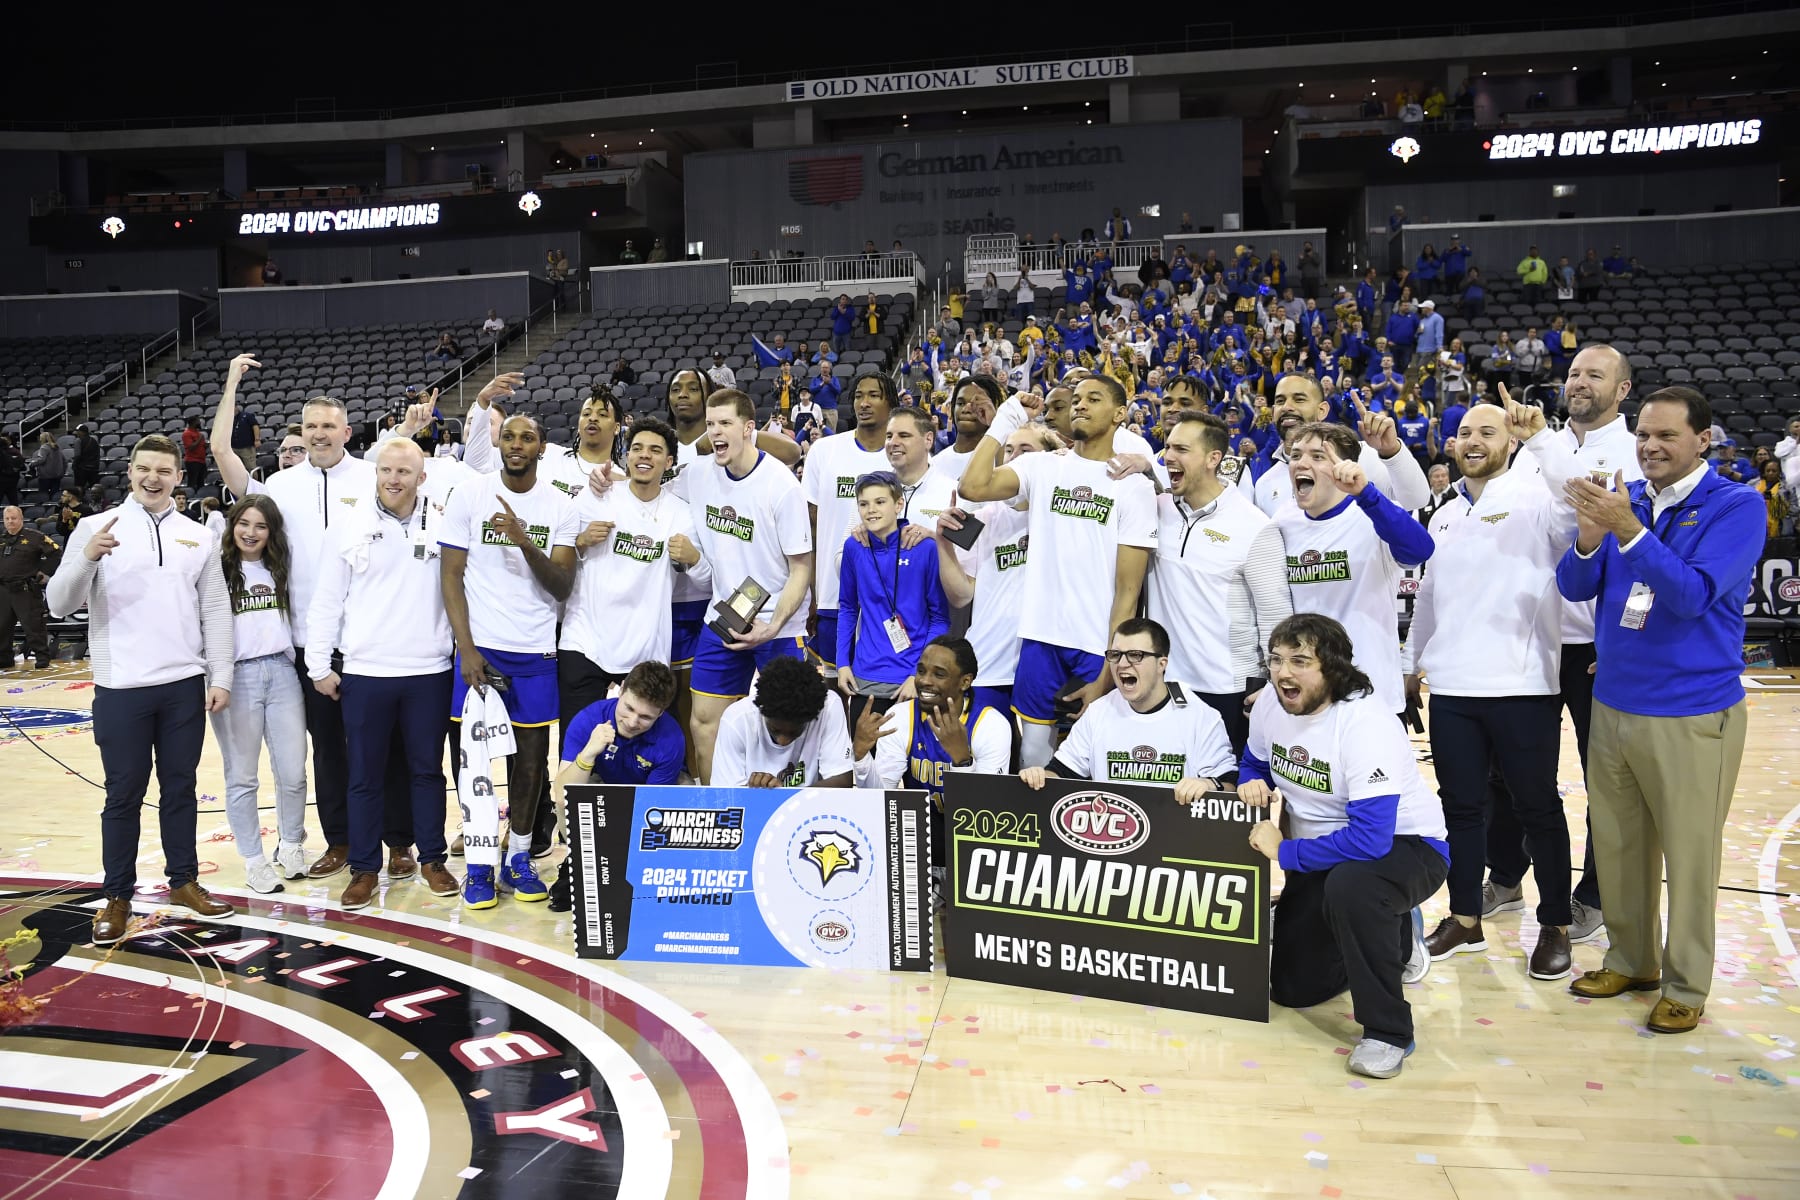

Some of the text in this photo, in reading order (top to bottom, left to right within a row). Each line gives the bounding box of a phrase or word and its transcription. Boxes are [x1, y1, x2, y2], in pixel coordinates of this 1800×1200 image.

[813, 58, 1129, 98] OLD NATIONAL SUITE CLUB
[1489, 119, 1762, 160] 2024 OVC CHAMPIONS
[878, 142, 1124, 178] German American
[879, 180, 1096, 204] Banking Insurance Investments
[239, 203, 440, 235] 2024 OVC CHAMPIONS
[943, 216, 1015, 236] SEATING
[785, 225, 800, 234] 105
[69, 260, 82, 268] 103
[1110, 762, 1182, 782] CHAMPIONS
[1272, 754, 1328, 791] CHAMPIONS
[1367, 776, 1390, 785] adidas
[598, 808, 606, 828] SEAT
[663, 811, 715, 828] MARCH
[953, 808, 1041, 843] 2024
[1071, 809, 1127, 837] OVC
[670, 828, 742, 844] MADNESS
[602, 866, 610, 885] ROW
[642, 868, 748, 887] 2024 TICKET
[890, 800, 903, 966] NCAA TOURNAMENT AUTOMATIC QUALIFIER
[657, 886, 733, 905] PUNCHED
[965, 847, 1248, 932] CHAMPIONS
[606, 922, 615, 955] SECTION
[663, 931, 730, 942] #MARCHMADNESS
[822, 928, 842, 937] OVC
[974, 932, 1235, 994] MEN'S BASKETBALL
